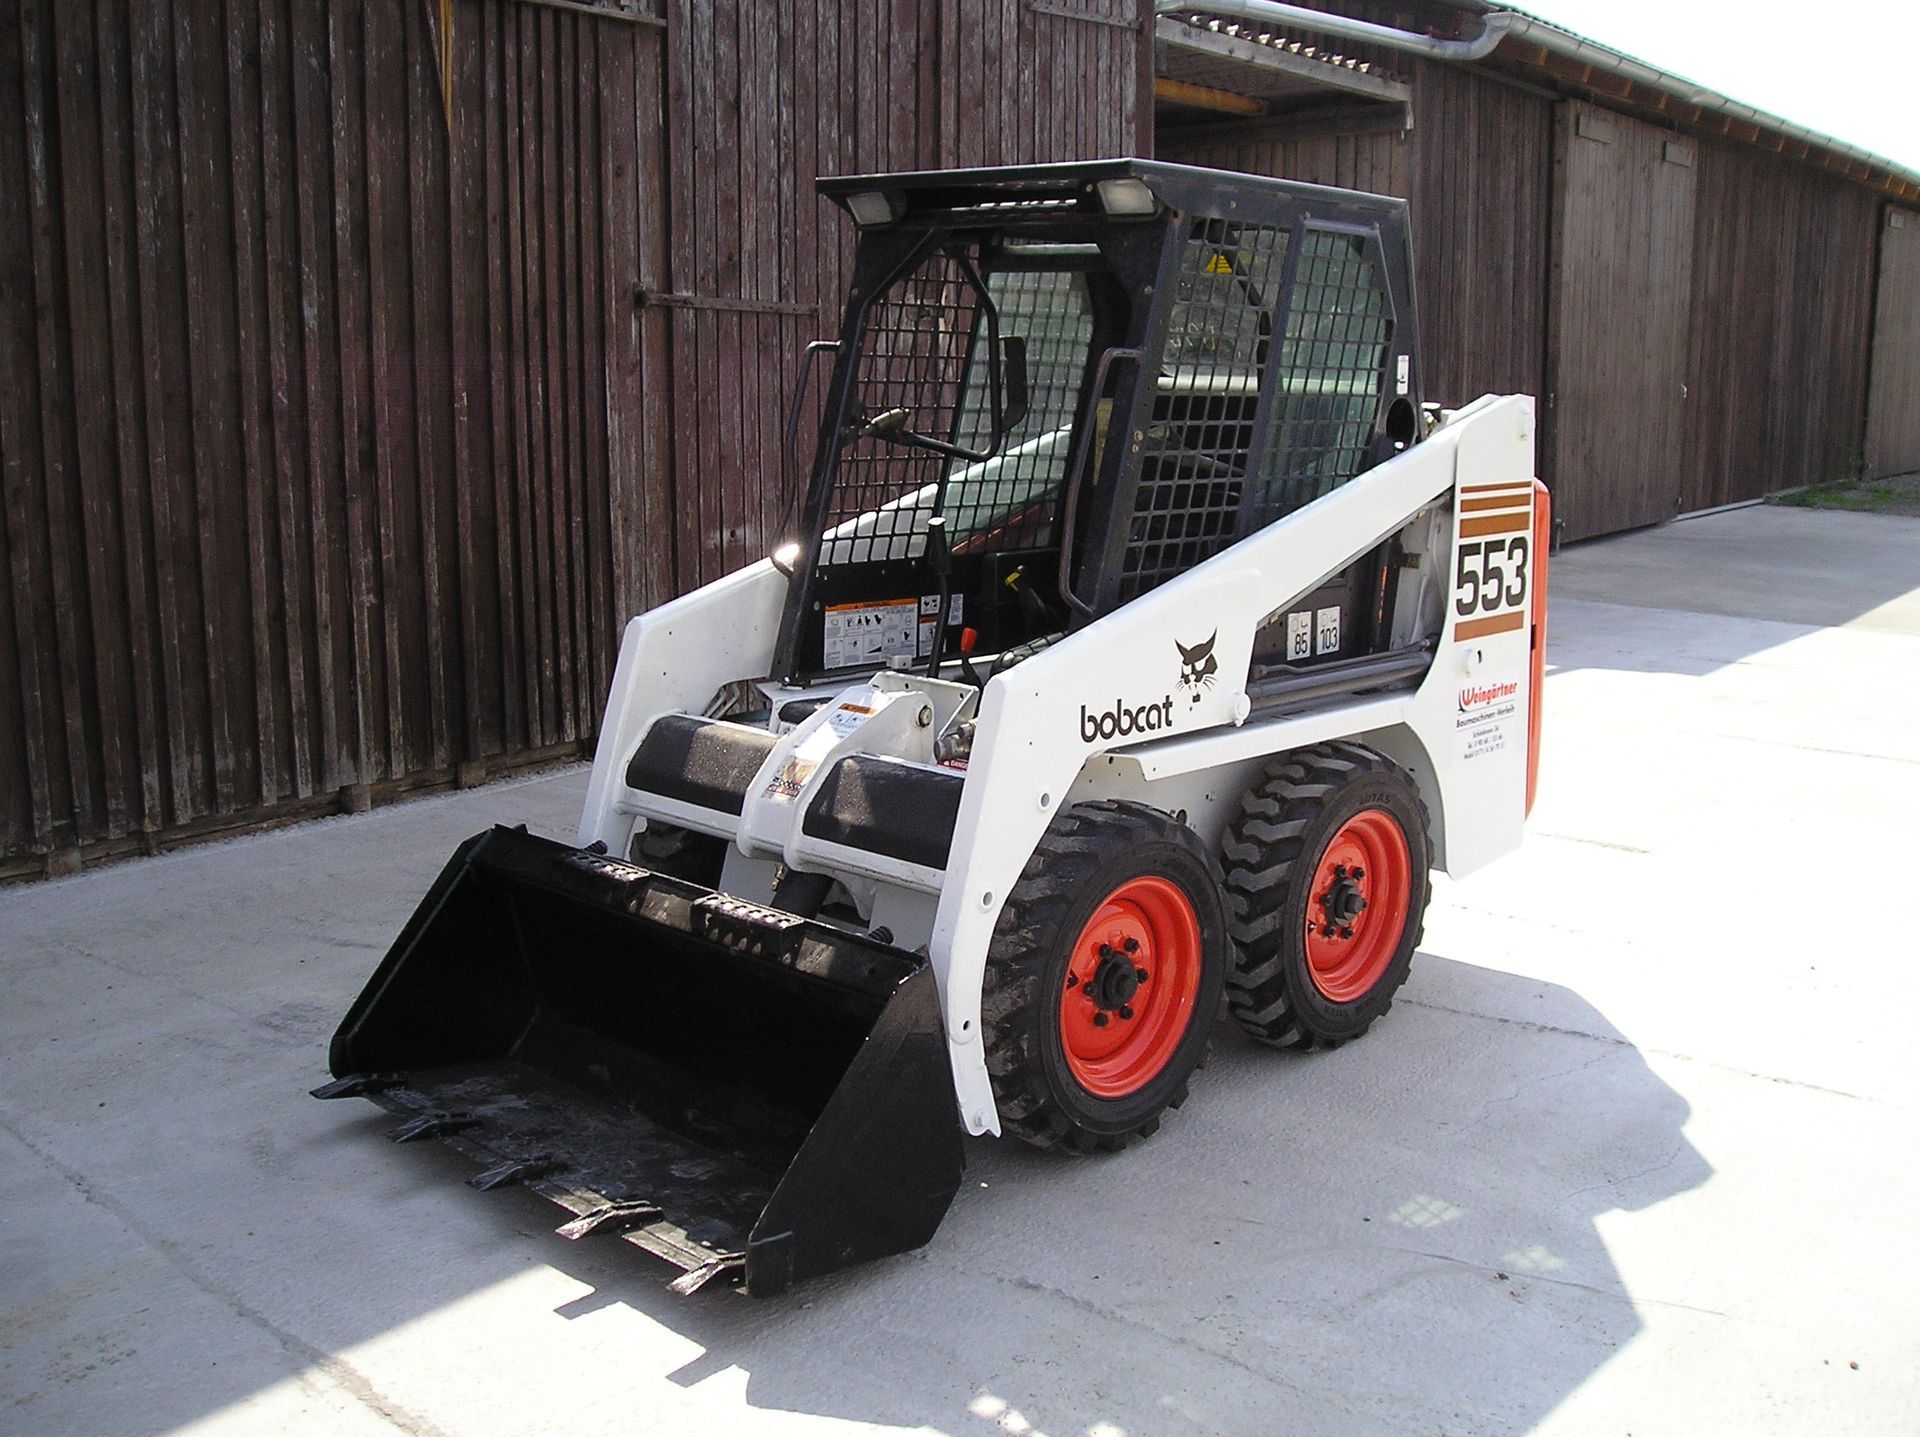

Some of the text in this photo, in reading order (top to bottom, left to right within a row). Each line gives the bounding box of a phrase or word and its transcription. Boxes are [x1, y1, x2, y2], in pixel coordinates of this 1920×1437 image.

[1456, 537, 1529, 616] 553
[1294, 631, 1308, 655] 85
[1320, 627, 1338, 650] 103
[1461, 682, 1518, 706] Weingärtner
[1080, 694, 1173, 743] bobcat
